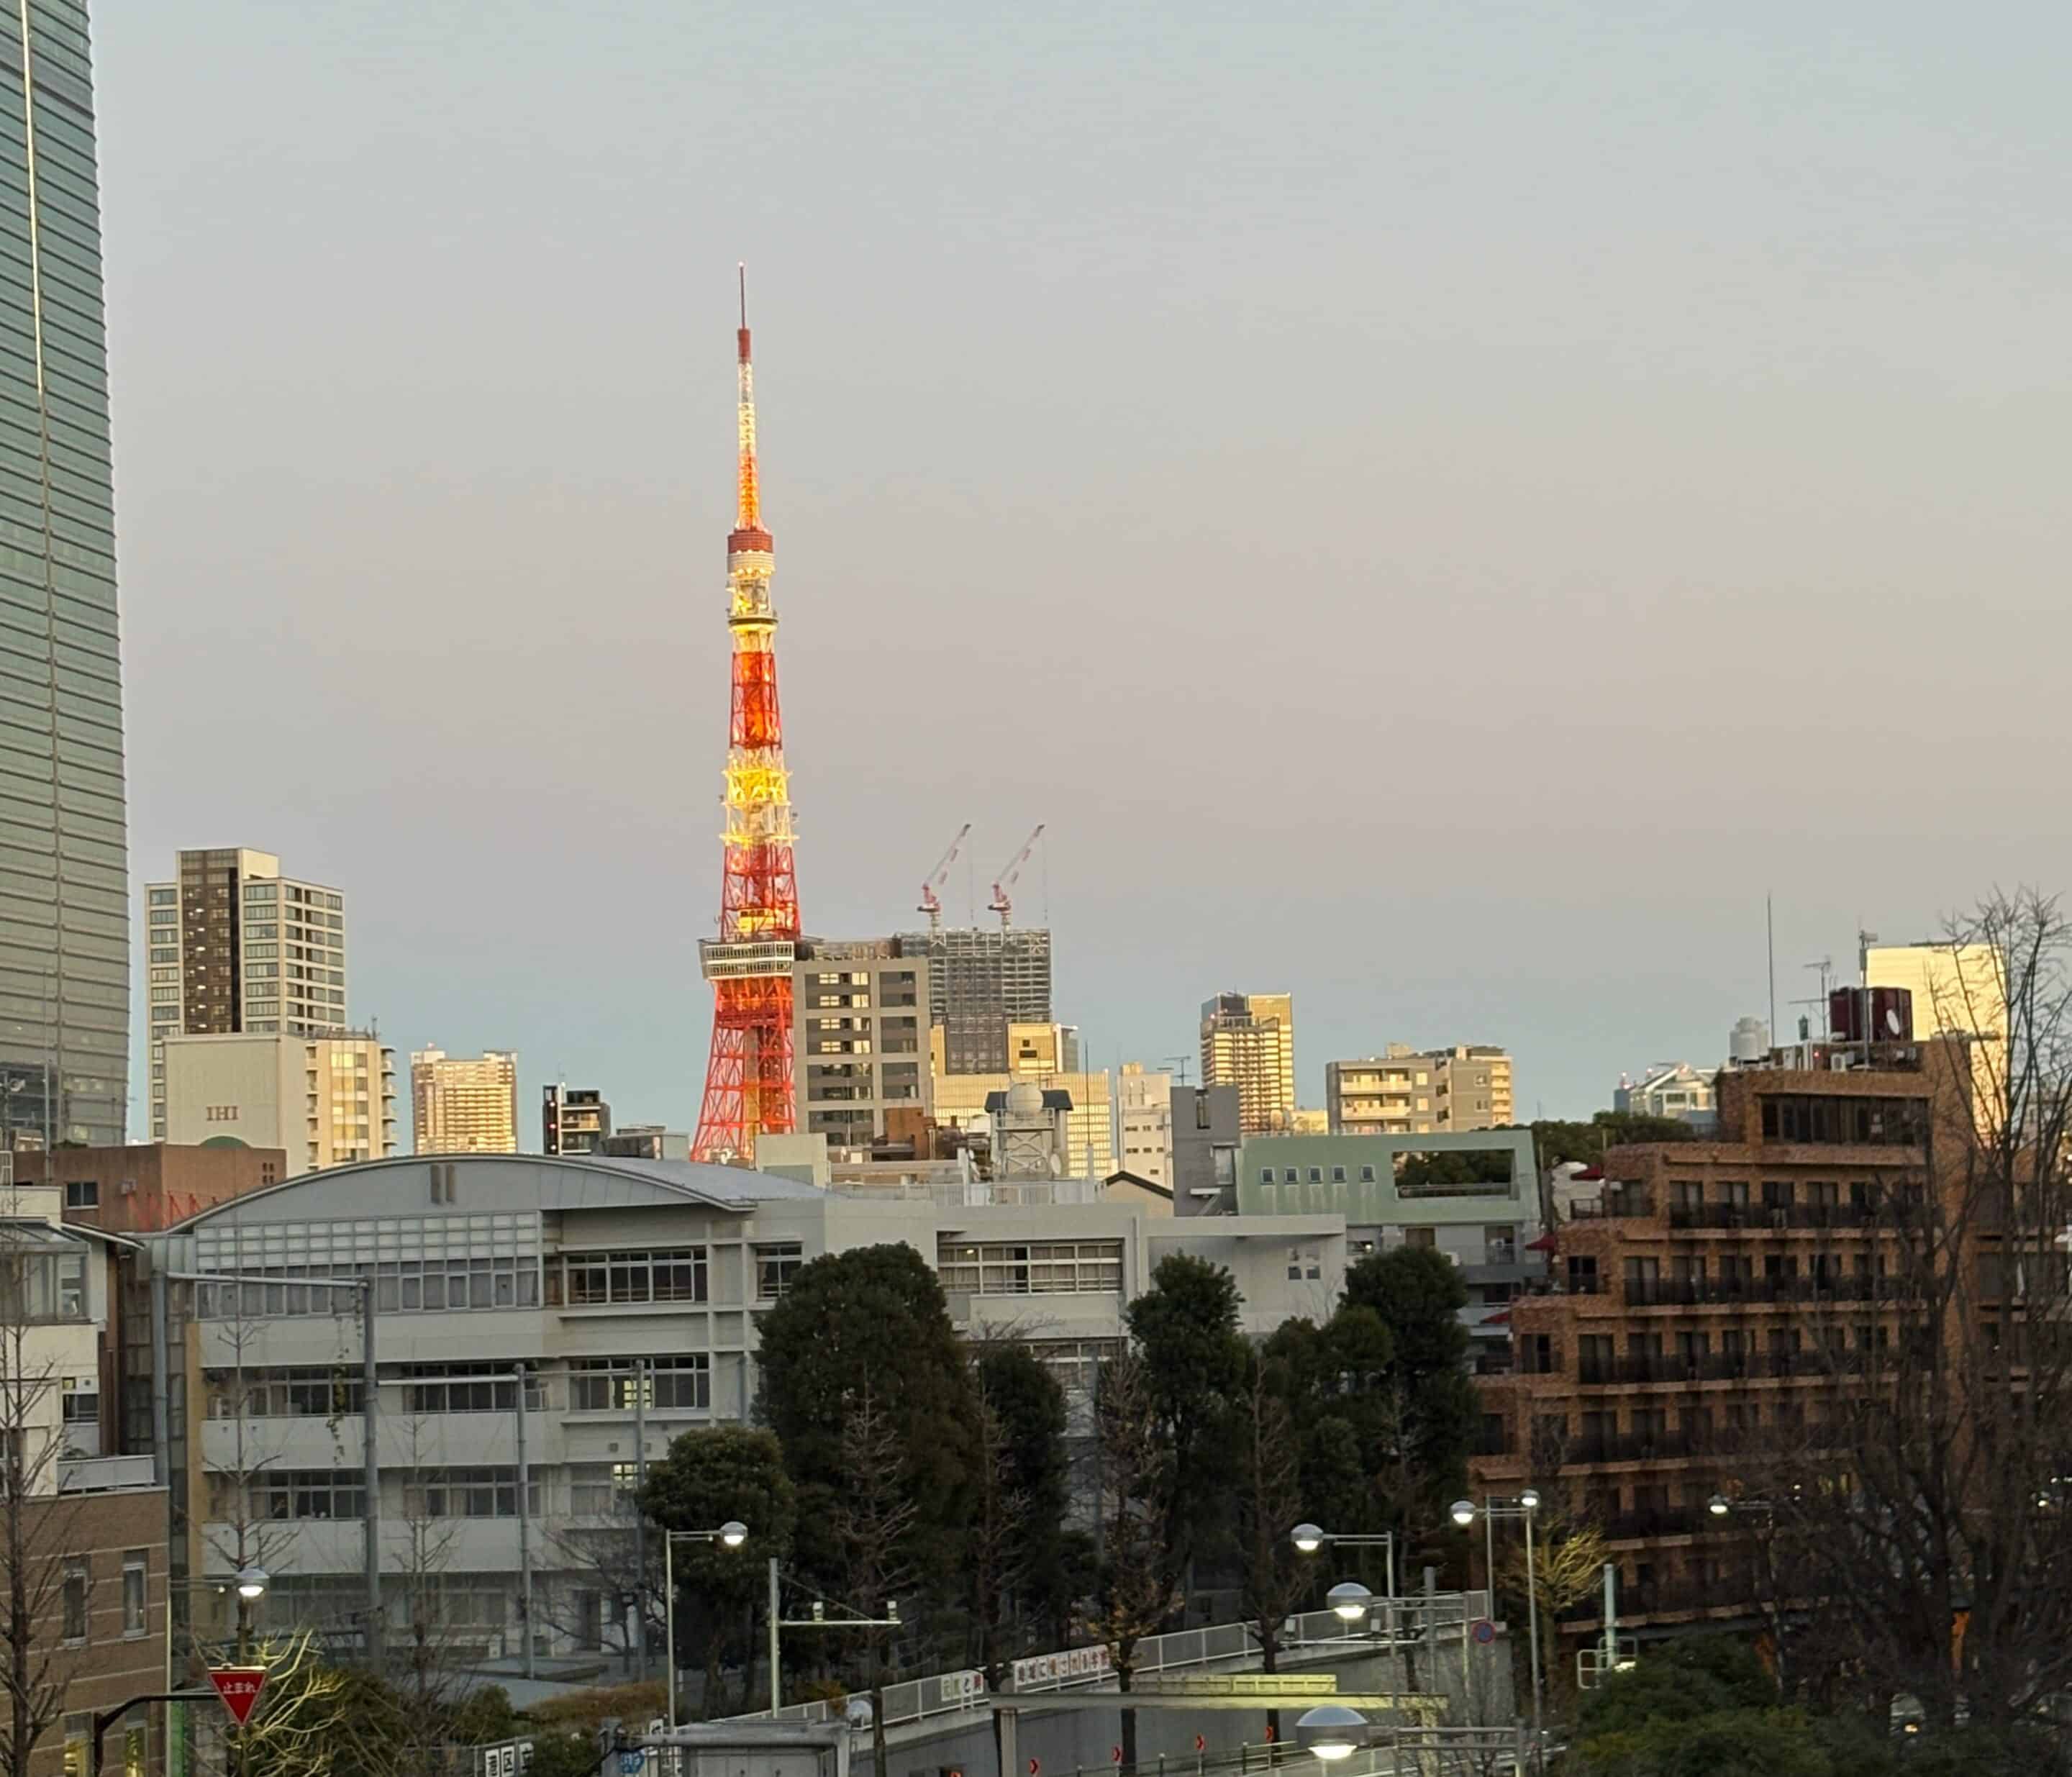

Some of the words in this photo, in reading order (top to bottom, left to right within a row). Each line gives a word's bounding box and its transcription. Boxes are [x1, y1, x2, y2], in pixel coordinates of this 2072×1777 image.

[206, 1106, 238, 1121] IHI
[223, 1681, 257, 1694] 止まれ
